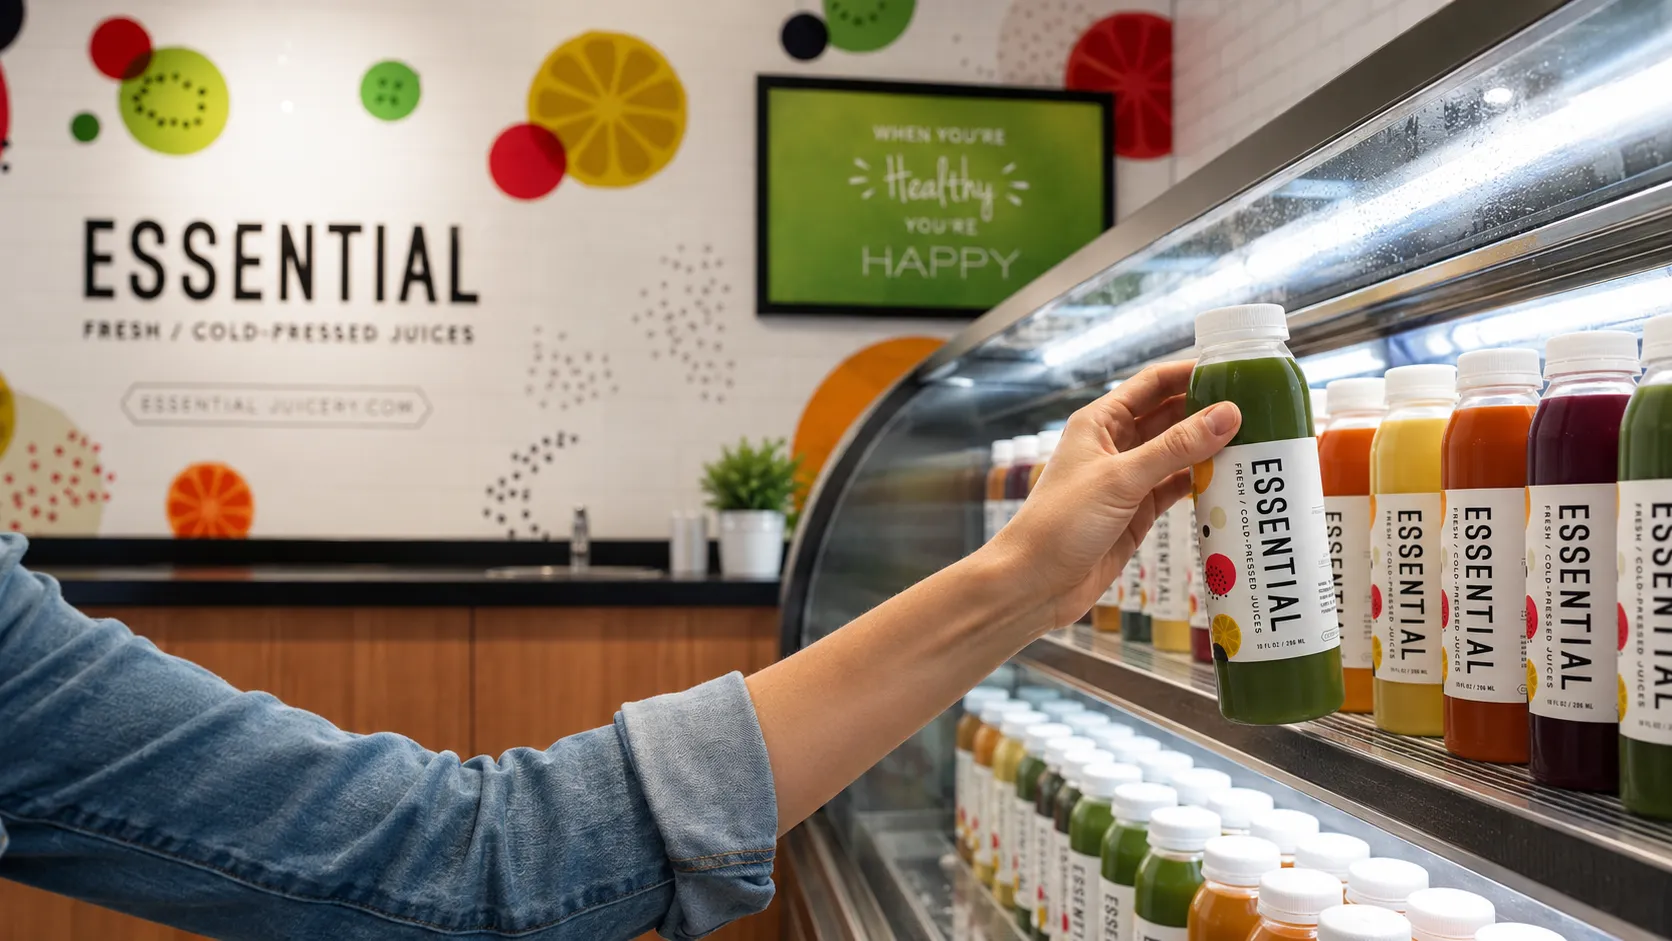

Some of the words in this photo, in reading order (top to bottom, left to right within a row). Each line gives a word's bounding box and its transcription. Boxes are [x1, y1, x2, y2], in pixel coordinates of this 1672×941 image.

[872, 125, 931, 143] WHEN
[936, 127, 1006, 146] YOU'RE
[883, 154, 994, 222] Healthy
[83, 218, 480, 305] ESSENTIAL
[861, 245, 1021, 279] HAPPY
[83, 320, 160, 341] FRESH
[191, 321, 379, 343] COLD-PRESSED
[390, 324, 476, 345] JUICES
[1235, 463, 1245, 496] FRESH
[1240, 508, 1257, 590] COLD-PRESSED
[1251, 595, 1262, 634] JUICES
[1251, 458, 1302, 633] ESSENTIAL
[1634, 502, 1643, 542] FRESH
[1398, 510, 1426, 661] ESSENTIAL
[1465, 507, 1494, 674] ESSENTIAL
[1544, 554, 1553, 642] COLD-PRESSED
[1558, 505, 1592, 691] ESSENTIAL
[1636, 661, 1646, 708] JUICES
[1072, 864, 1086, 941] ESSENTI
[1104, 893, 1119, 941] ESSE
